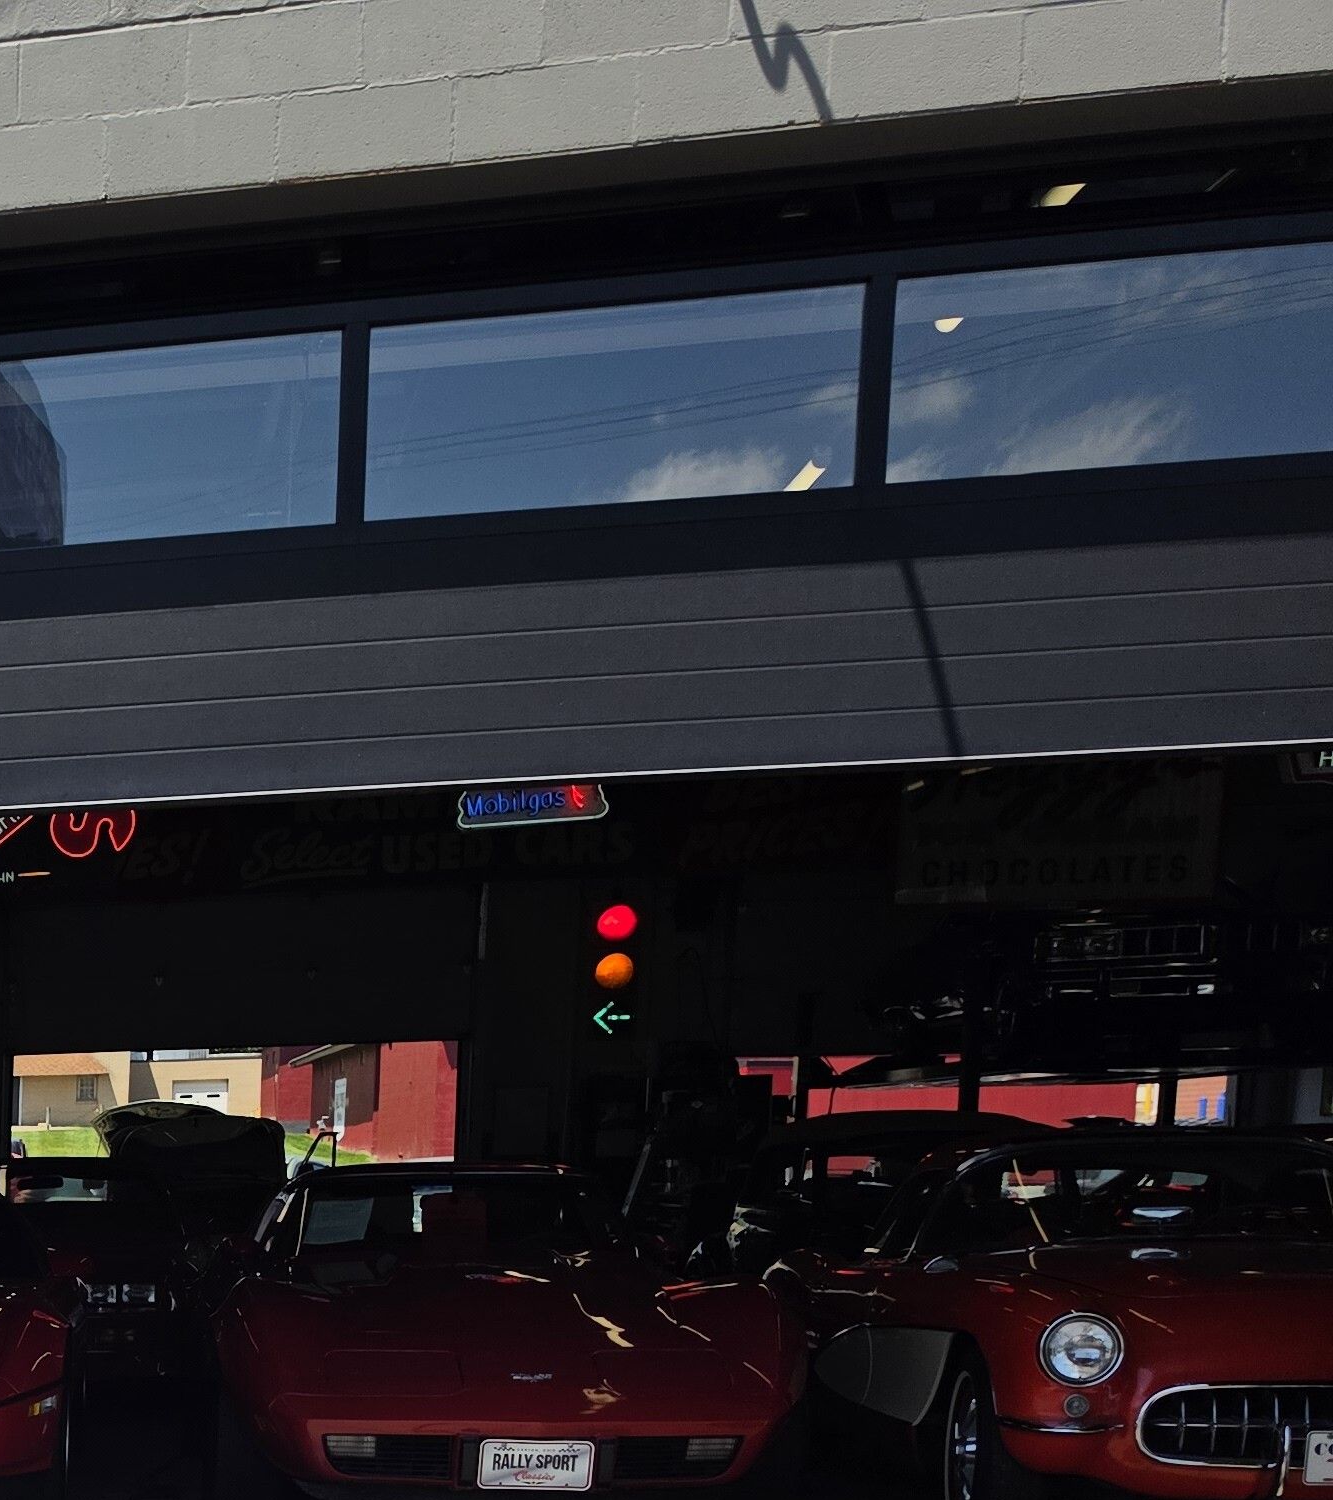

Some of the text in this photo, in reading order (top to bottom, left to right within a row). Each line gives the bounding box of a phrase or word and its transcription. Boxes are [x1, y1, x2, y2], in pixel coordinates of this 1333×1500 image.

[466, 789, 566, 817] Mobilgas
[921, 855, 1189, 887] CHOCOLATES
[492, 1453, 579, 1472] RALLY SPORT
